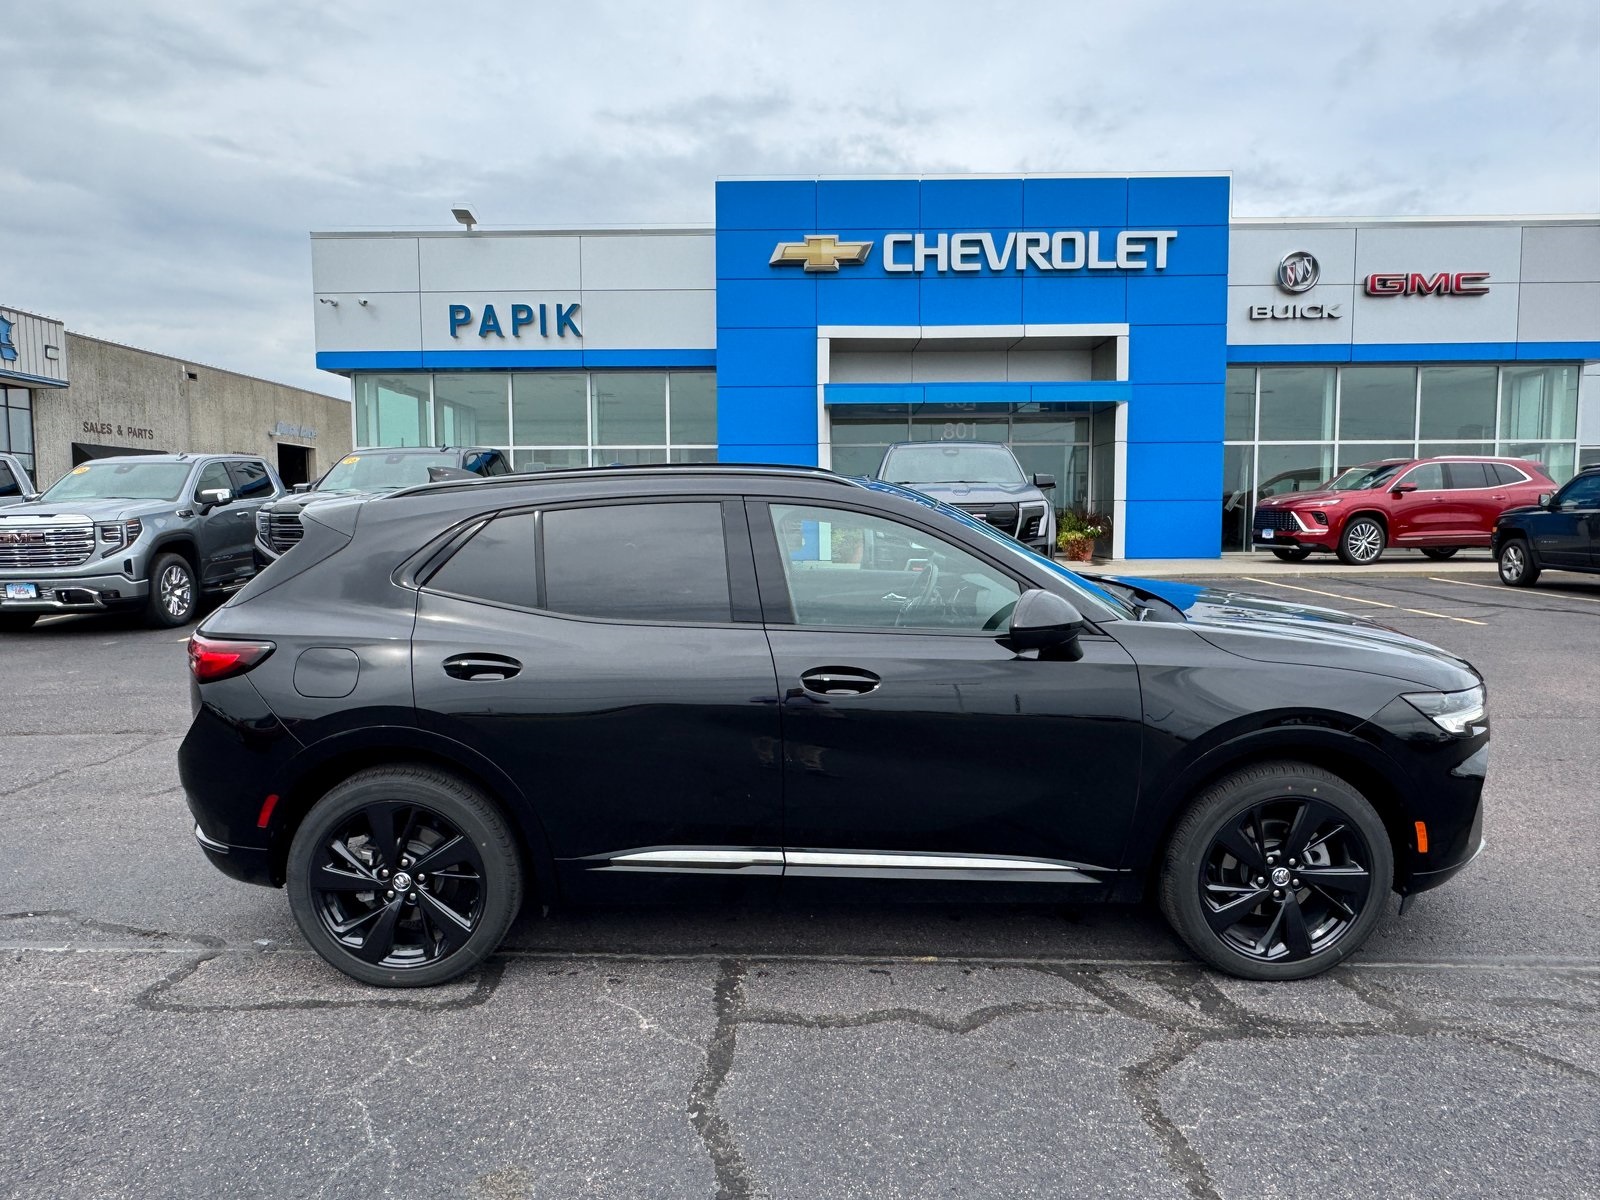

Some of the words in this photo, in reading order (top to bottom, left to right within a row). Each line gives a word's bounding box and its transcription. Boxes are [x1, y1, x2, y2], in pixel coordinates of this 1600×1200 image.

[882, 230, 1178, 272] CHEVROLET
[1364, 272, 1491, 297] GMC
[448, 303, 583, 338] PAPIK
[1249, 303, 1343, 320] BUICK
[83, 421, 112, 435] SALES
[117, 424, 123, 436] &
[127, 426, 154, 440] PARTS
[943, 422, 977, 439] 801
